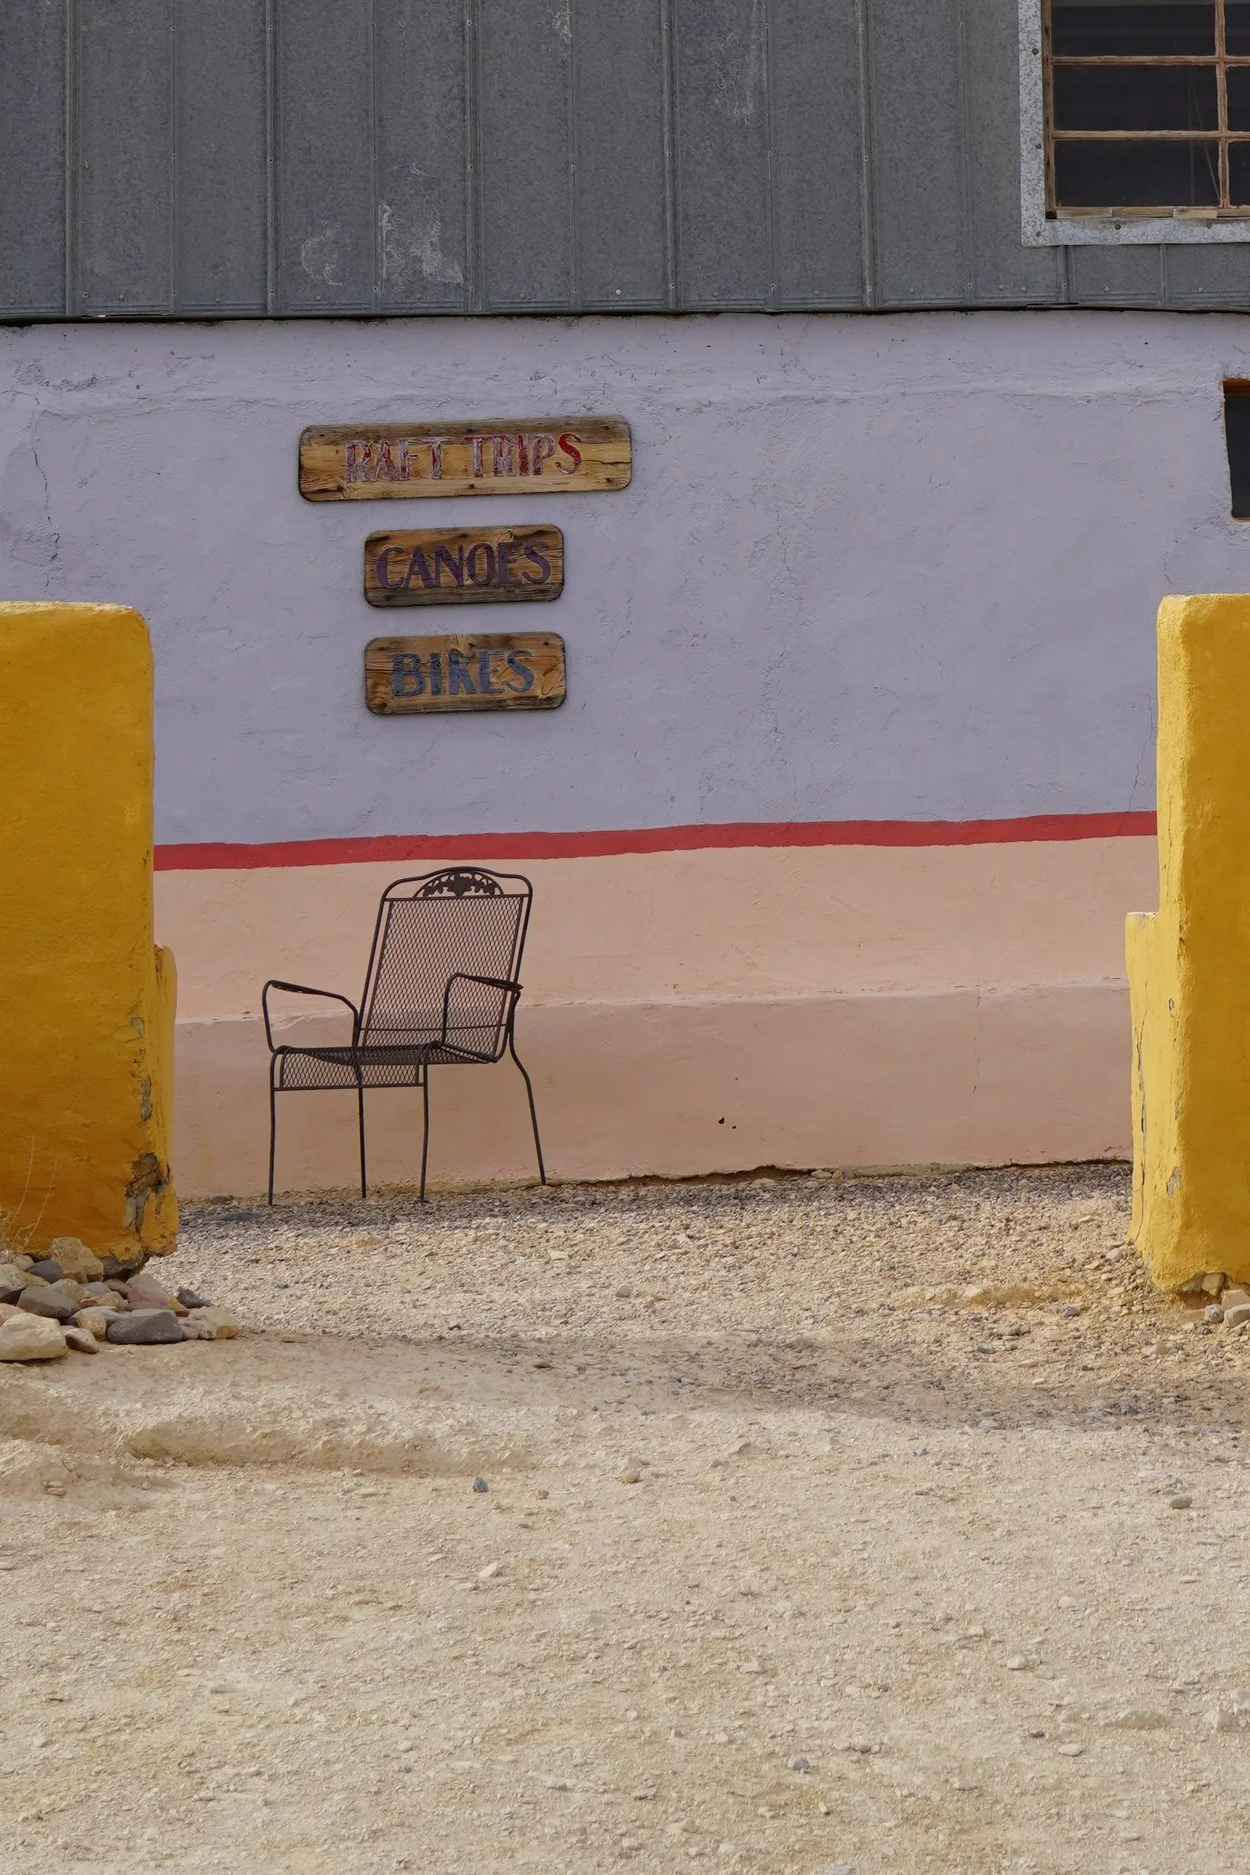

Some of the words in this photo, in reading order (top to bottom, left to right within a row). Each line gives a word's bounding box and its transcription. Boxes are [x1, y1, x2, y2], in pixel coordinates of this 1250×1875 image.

[344, 436, 450, 483] RAFT
[464, 432, 582, 478] TRIPS
[376, 540, 551, 590] CANOES
[391, 650, 534, 697] BIKES
